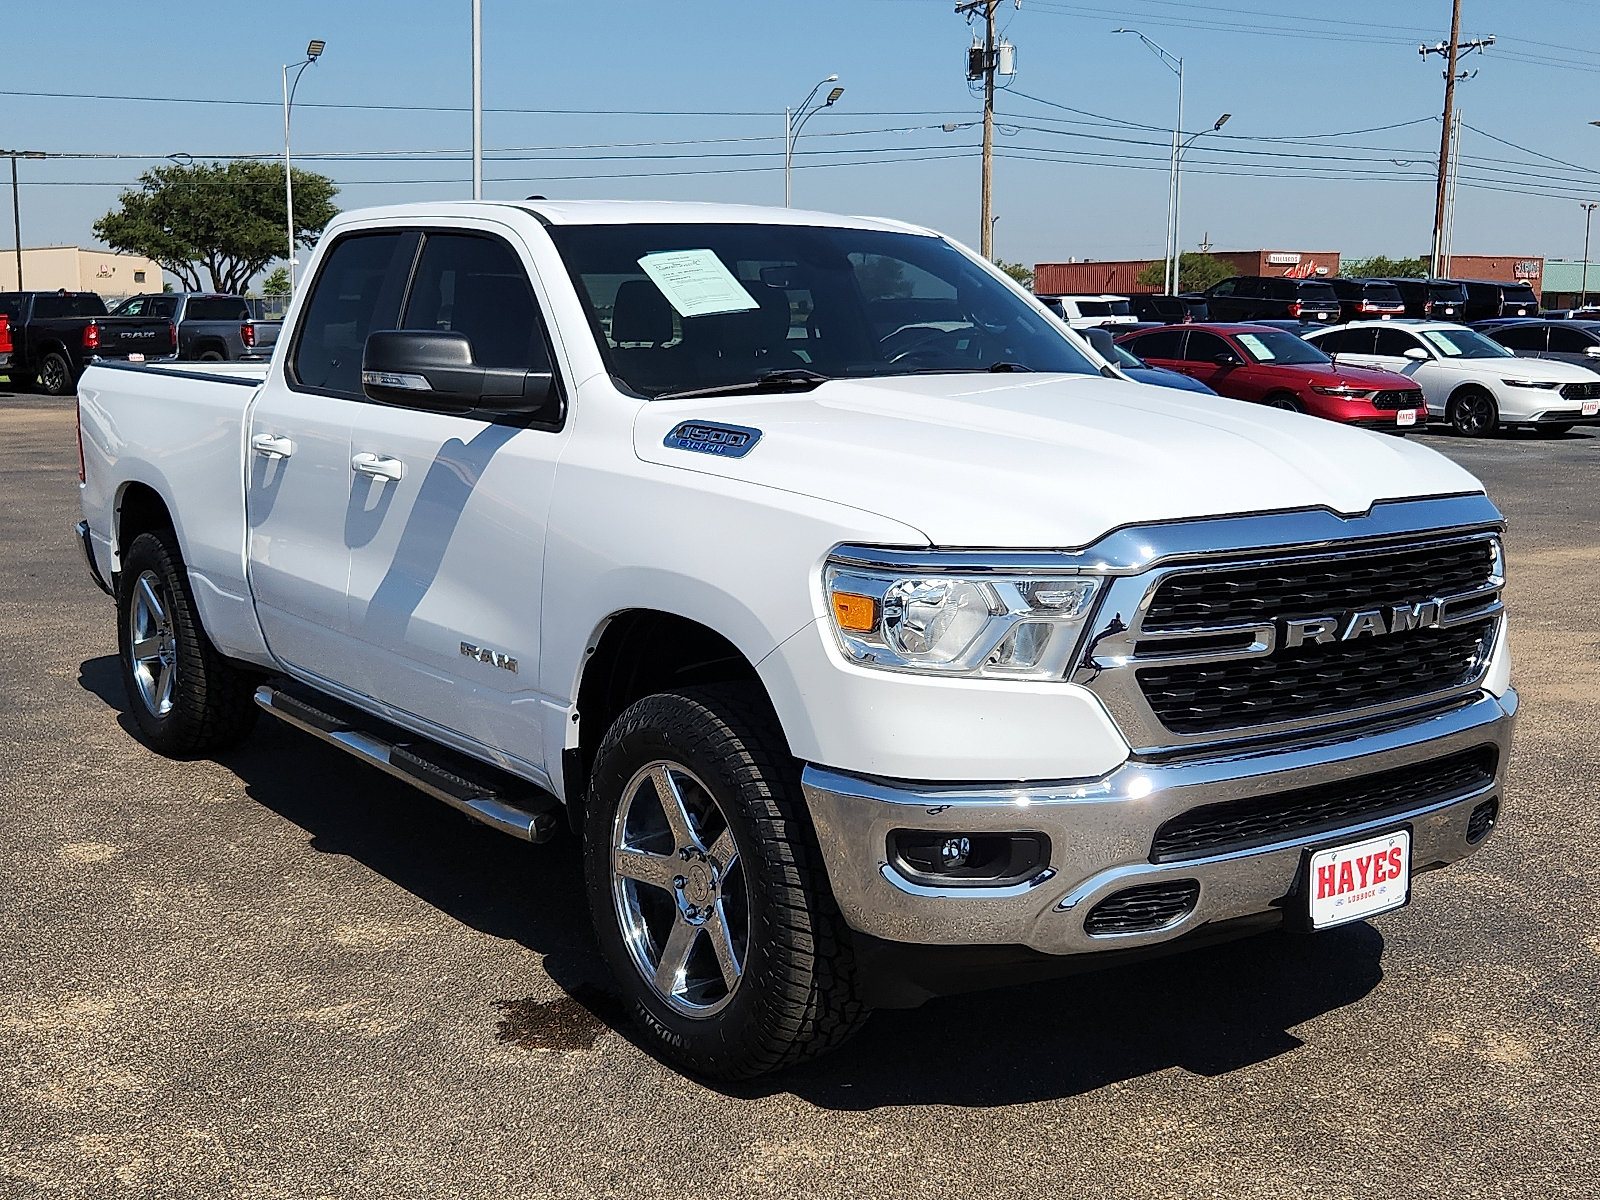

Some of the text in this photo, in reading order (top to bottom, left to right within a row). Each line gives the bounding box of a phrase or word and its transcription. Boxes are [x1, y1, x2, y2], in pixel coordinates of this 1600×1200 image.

[682, 426, 748, 446] 1500
[1284, 601, 1435, 649] RAM
[460, 641, 519, 675] RAM
[1316, 847, 1402, 900] HAYES
[1347, 889, 1376, 904] LUBBOCK
